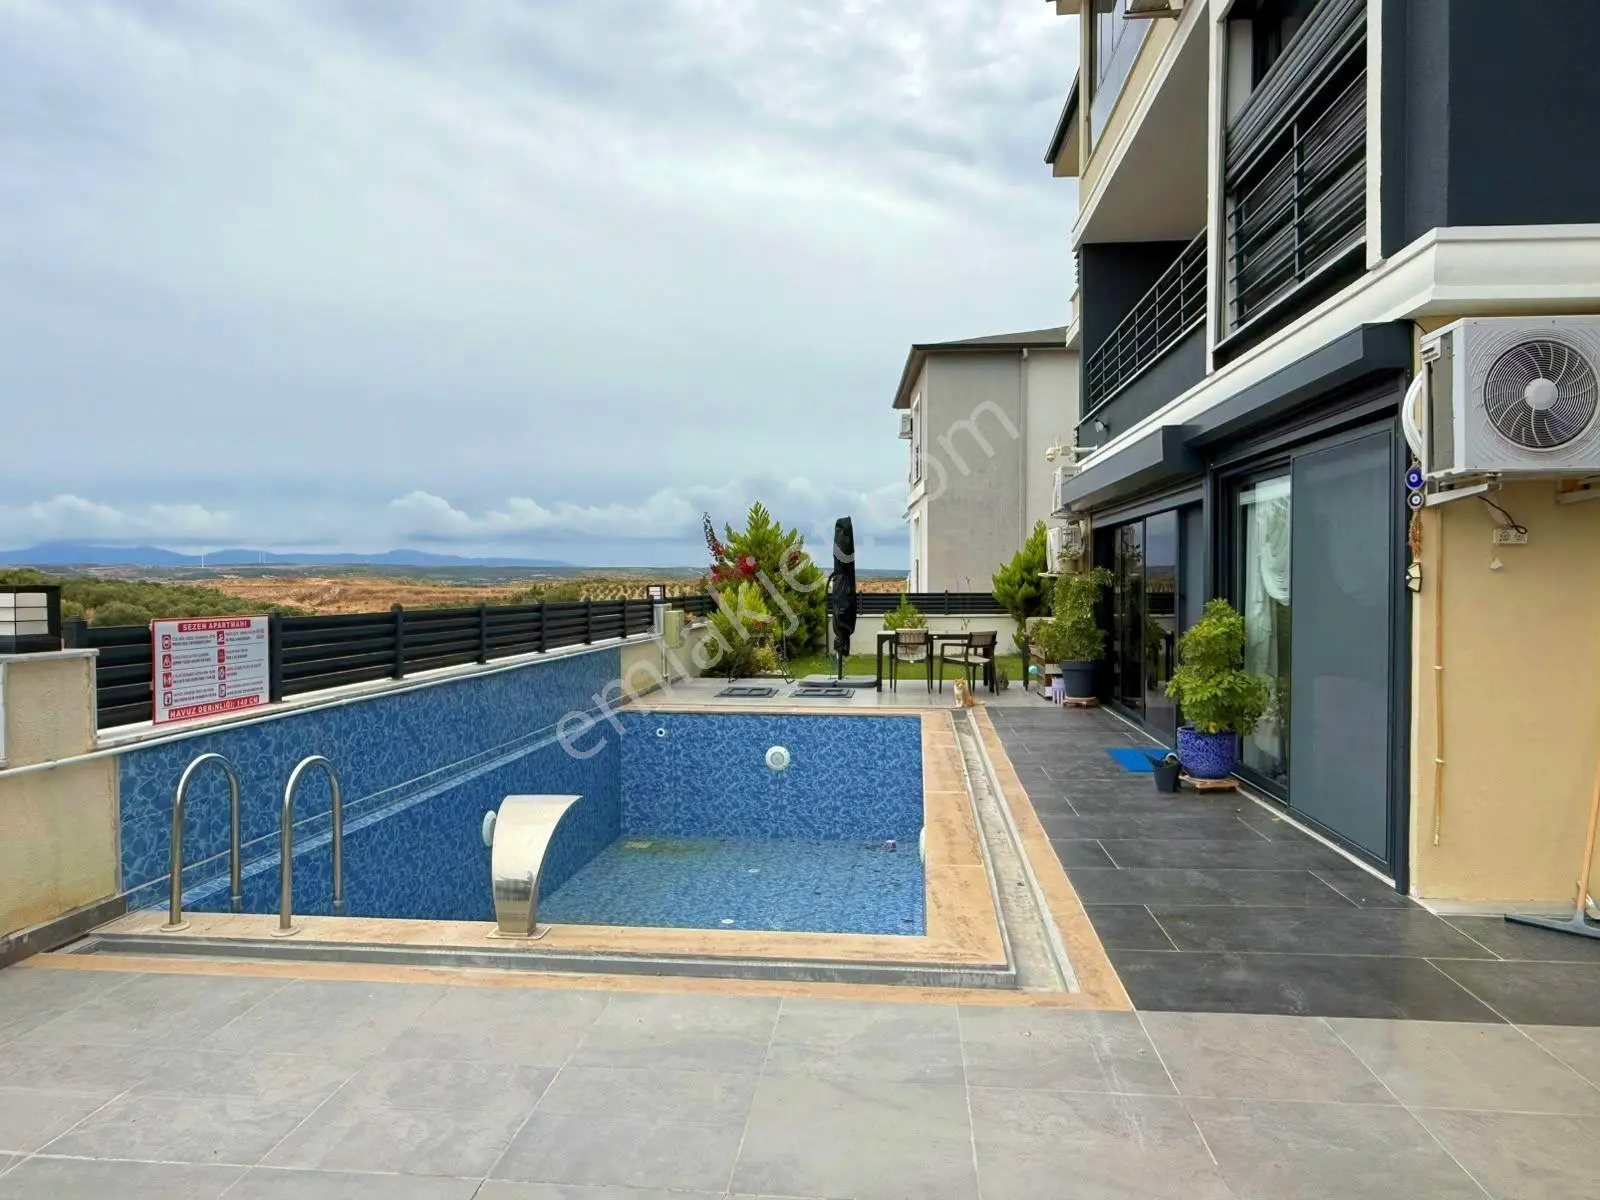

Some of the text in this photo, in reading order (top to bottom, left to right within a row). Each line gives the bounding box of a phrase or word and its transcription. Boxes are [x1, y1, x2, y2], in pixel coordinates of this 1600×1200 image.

[182, 623, 207, 631] SEZEN
[170, 707, 197, 718] HAVUZ
[237, 698, 248, 706] 140
[249, 696, 259, 704] CM
